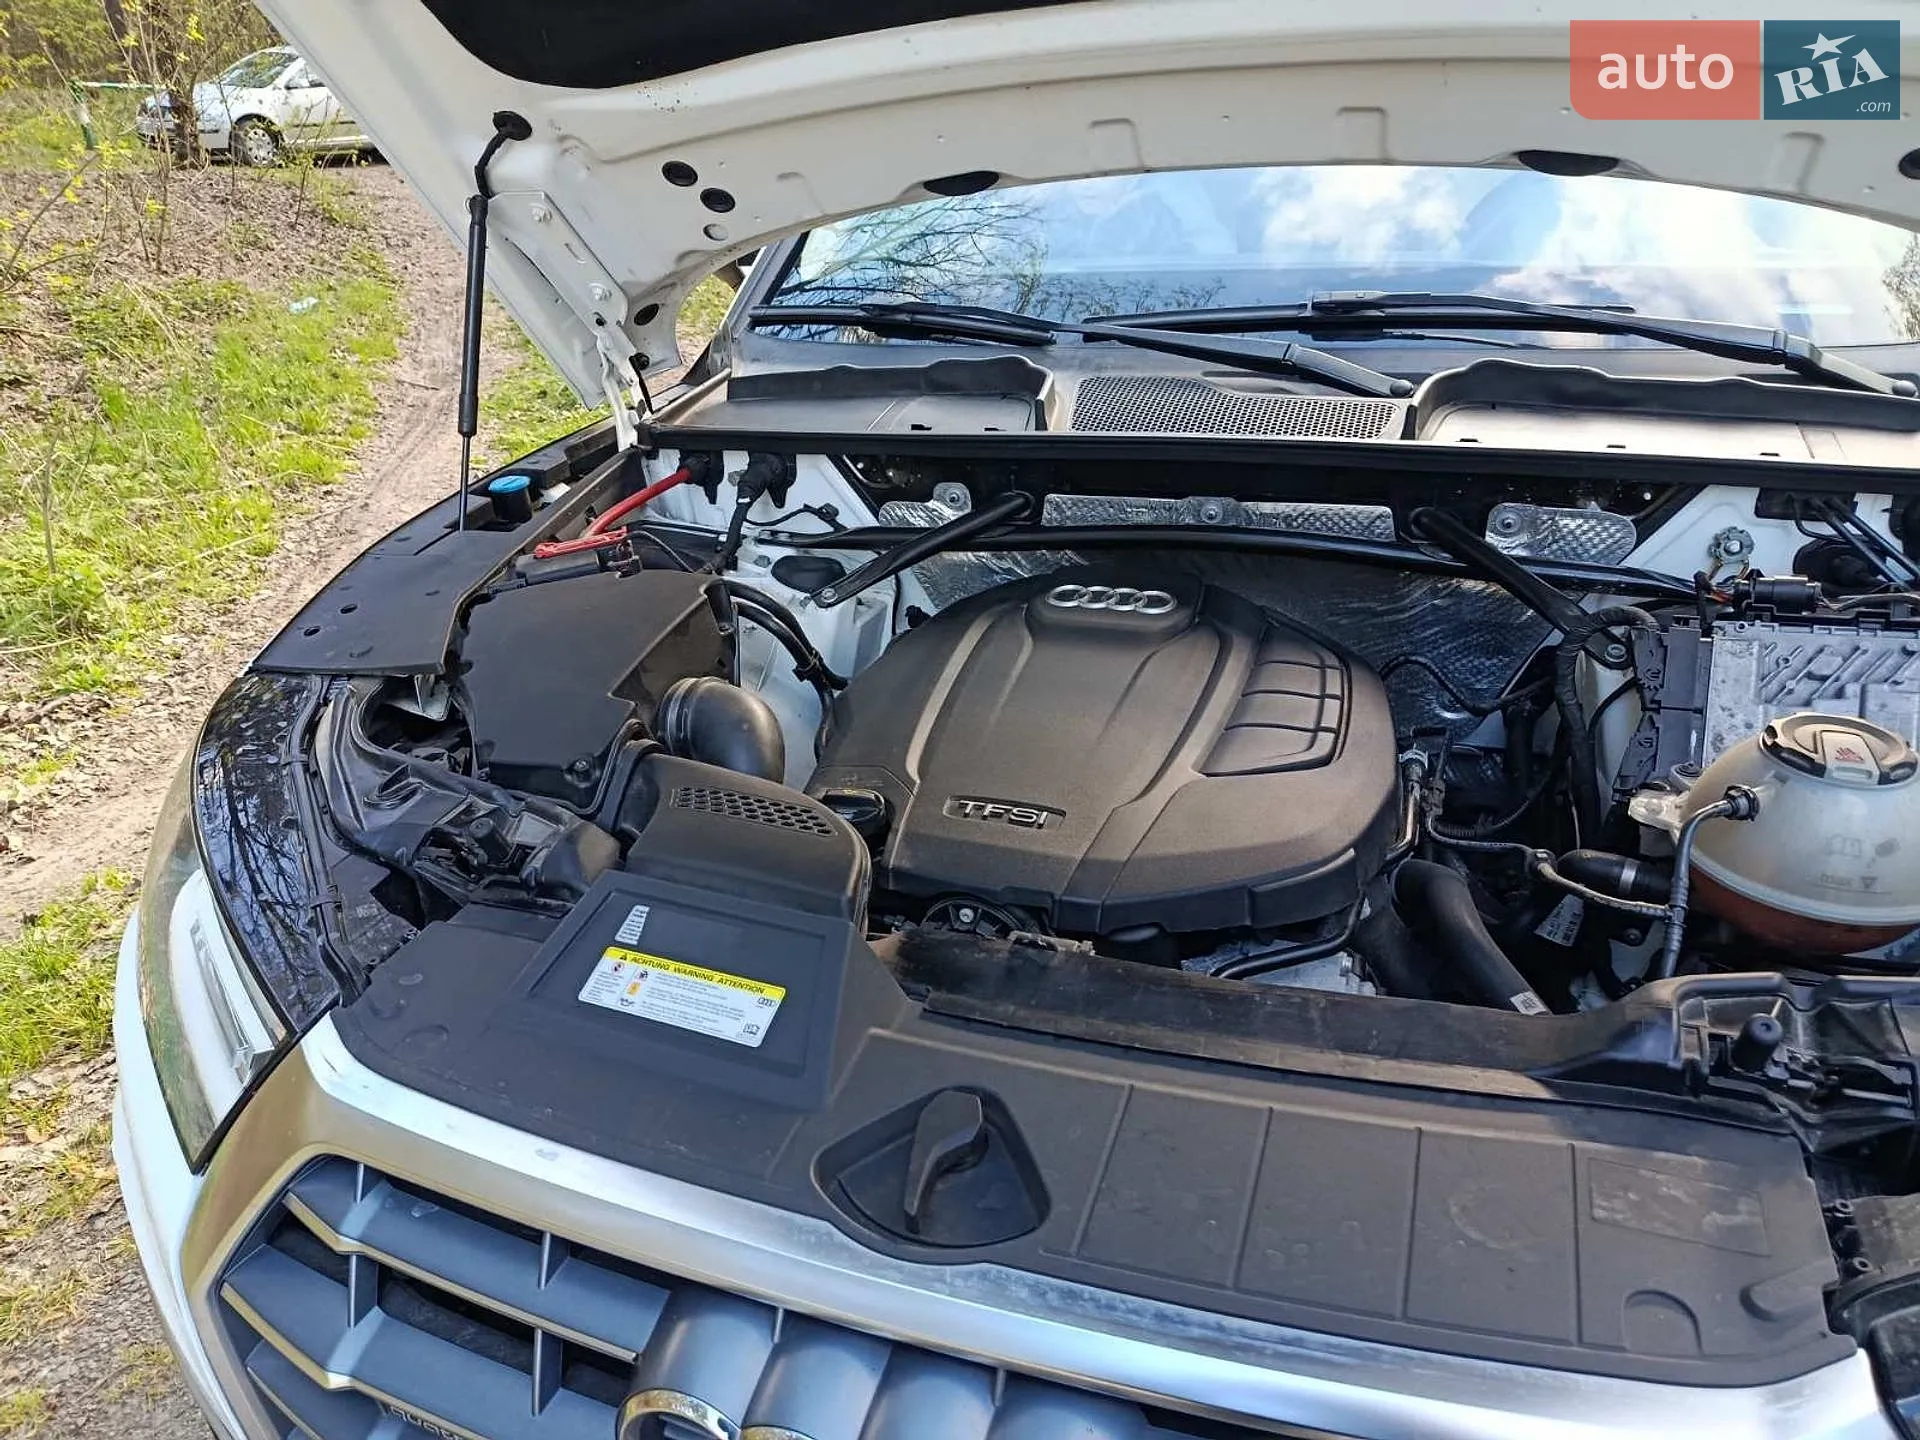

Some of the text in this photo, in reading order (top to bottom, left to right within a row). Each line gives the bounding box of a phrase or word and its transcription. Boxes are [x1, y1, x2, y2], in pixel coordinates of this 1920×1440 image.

[959, 800, 1048, 828] TFSI
[631, 956, 671, 971] ACHTUNG
[674, 966, 714, 982] WARNING
[717, 977, 766, 994] ATTENTION
